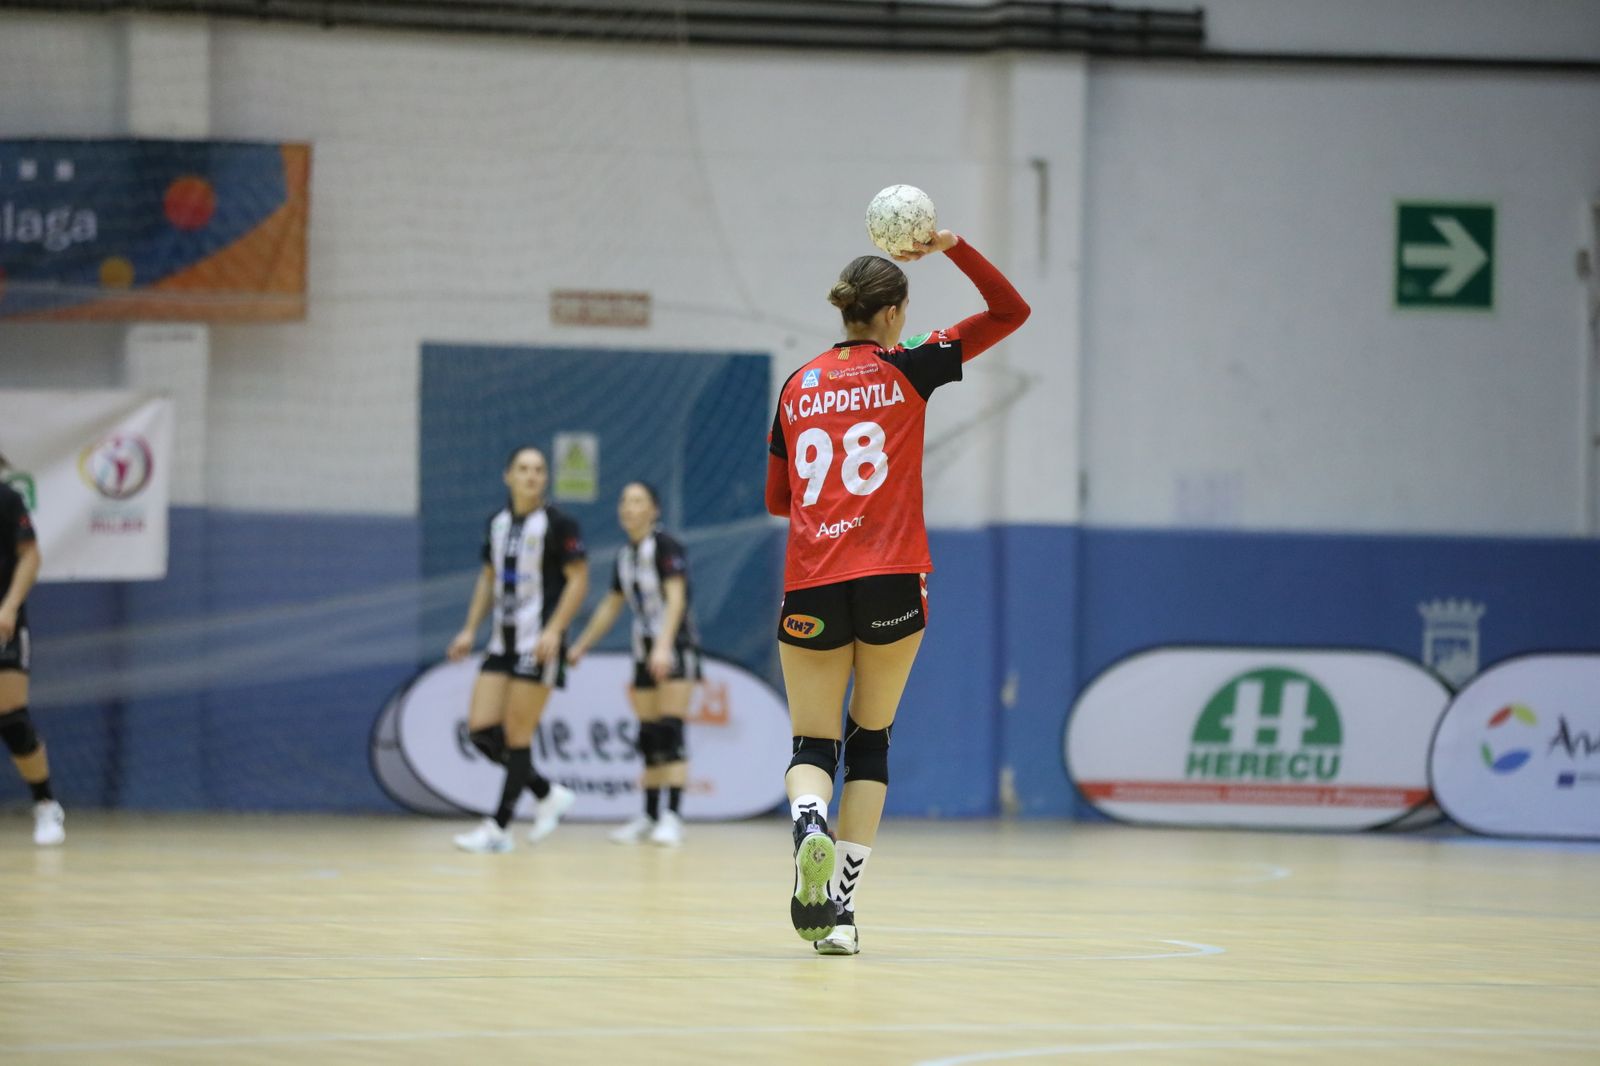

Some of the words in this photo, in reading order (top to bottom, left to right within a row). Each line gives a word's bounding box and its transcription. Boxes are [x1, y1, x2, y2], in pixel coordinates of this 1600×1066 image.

[799, 380, 905, 418] CAPDEVILA
[795, 421, 888, 507] 98
[816, 514, 865, 539] Agbar
[1185, 751, 1342, 780] HERECU
